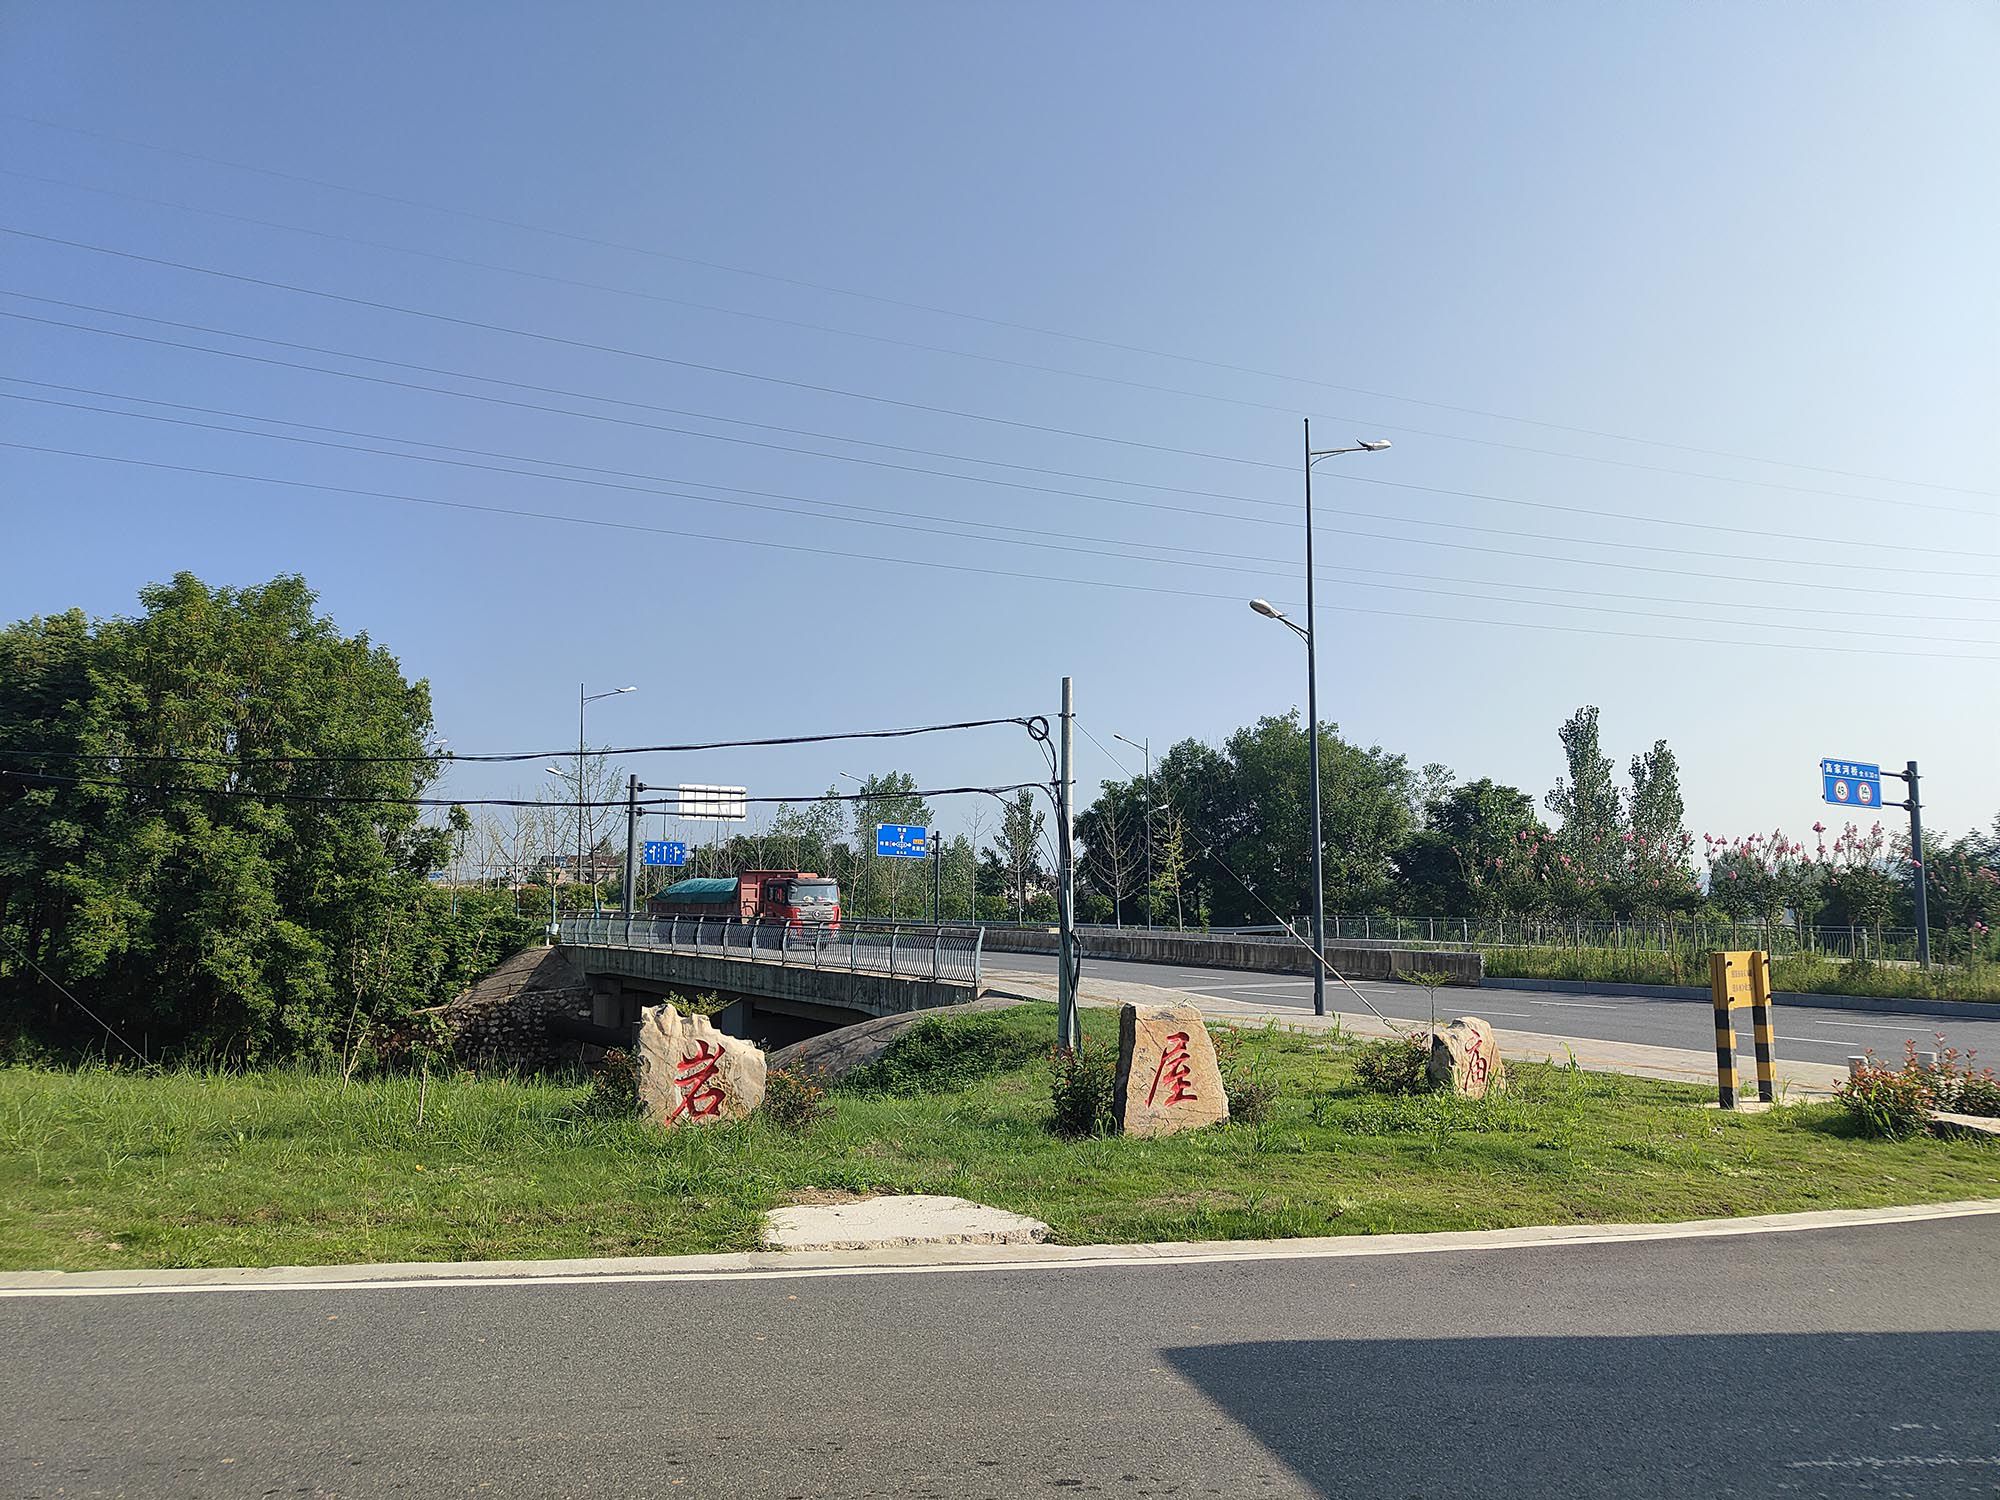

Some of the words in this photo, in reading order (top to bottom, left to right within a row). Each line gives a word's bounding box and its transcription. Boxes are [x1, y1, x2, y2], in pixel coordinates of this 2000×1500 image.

[1825, 762, 1858, 776] 高家河桥
[664, 1039, 726, 1126] 岩
[1144, 1031, 1198, 1107] 屋
[1464, 1029, 1487, 1092] 庙
